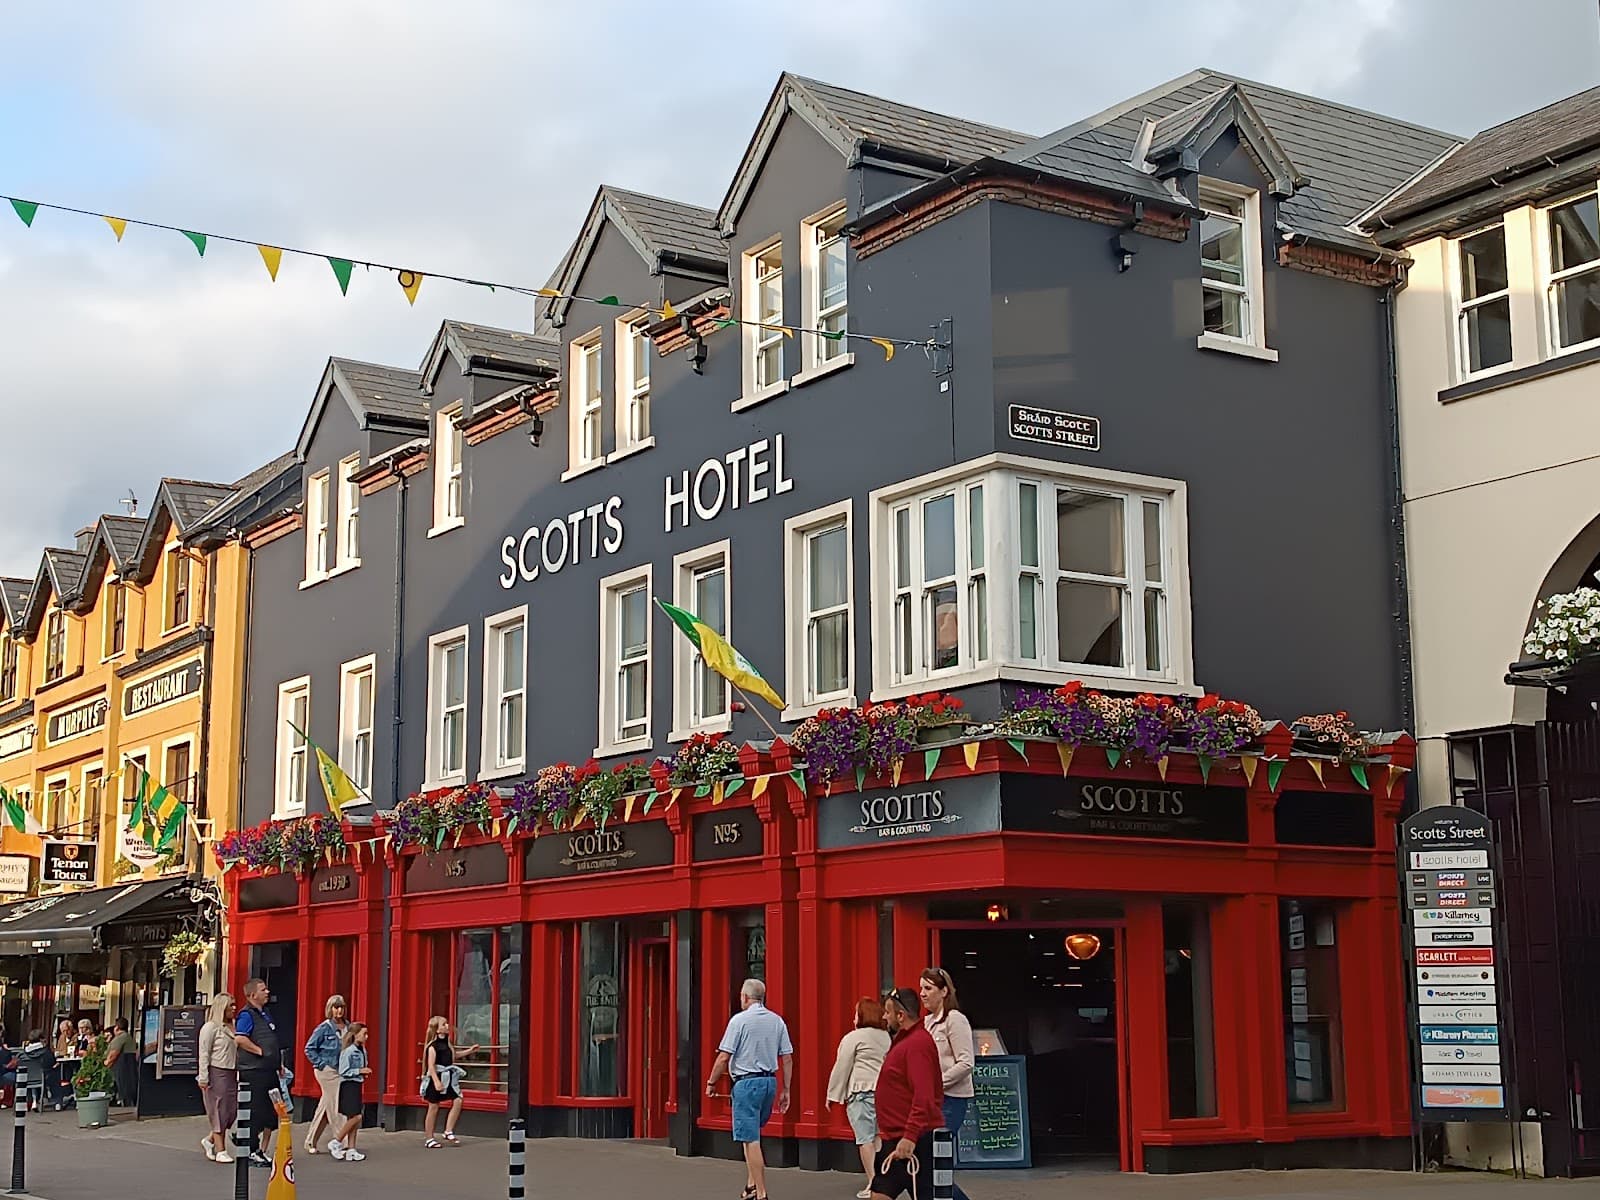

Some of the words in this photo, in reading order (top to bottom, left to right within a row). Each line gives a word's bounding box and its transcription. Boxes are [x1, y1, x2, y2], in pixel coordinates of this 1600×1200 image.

[1013, 424, 1053, 439] SCOTTS
[1055, 430, 1096, 445] STREET
[499, 495, 624, 590] SCOTTS
[664, 433, 793, 532] HOTEL
[131, 669, 189, 713] RESTAURANT
[57, 706, 100, 739] MURPHYS
[861, 790, 943, 826] SCOTTS
[1080, 784, 1184, 815] SCOTTS
[568, 831, 623, 857] SCOTTS
[1410, 827, 1447, 840] Scotts
[1449, 826, 1486, 838] Street
[51, 857, 88, 869] Tenon
[52, 869, 87, 881] Tours
[1419, 952, 1458, 961] SCARLETT
[973, 1064, 1009, 1077] PECIALS
